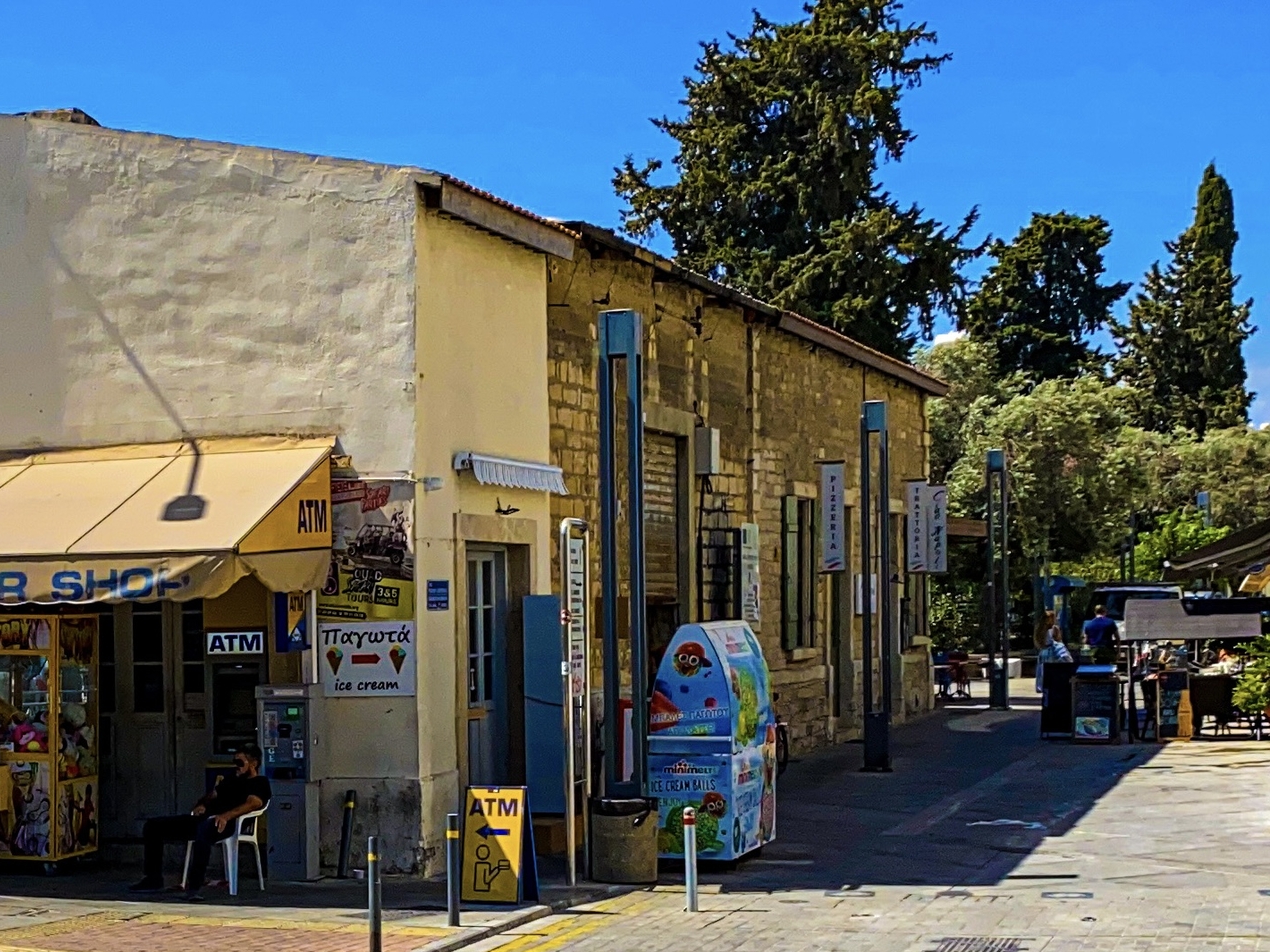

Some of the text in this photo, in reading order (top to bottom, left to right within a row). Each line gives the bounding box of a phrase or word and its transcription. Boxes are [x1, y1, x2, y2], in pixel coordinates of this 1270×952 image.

[298, 500, 327, 533] ATM
[377, 587, 398, 598] 3&5
[289, 595, 304, 611] ATM
[209, 635, 260, 652] ATM
[322, 624, 411, 649] Παγωτά
[335, 678, 399, 691] ice cream
[651, 778, 716, 792] ICE CREAM BALLS
[469, 798, 518, 817] ATM
